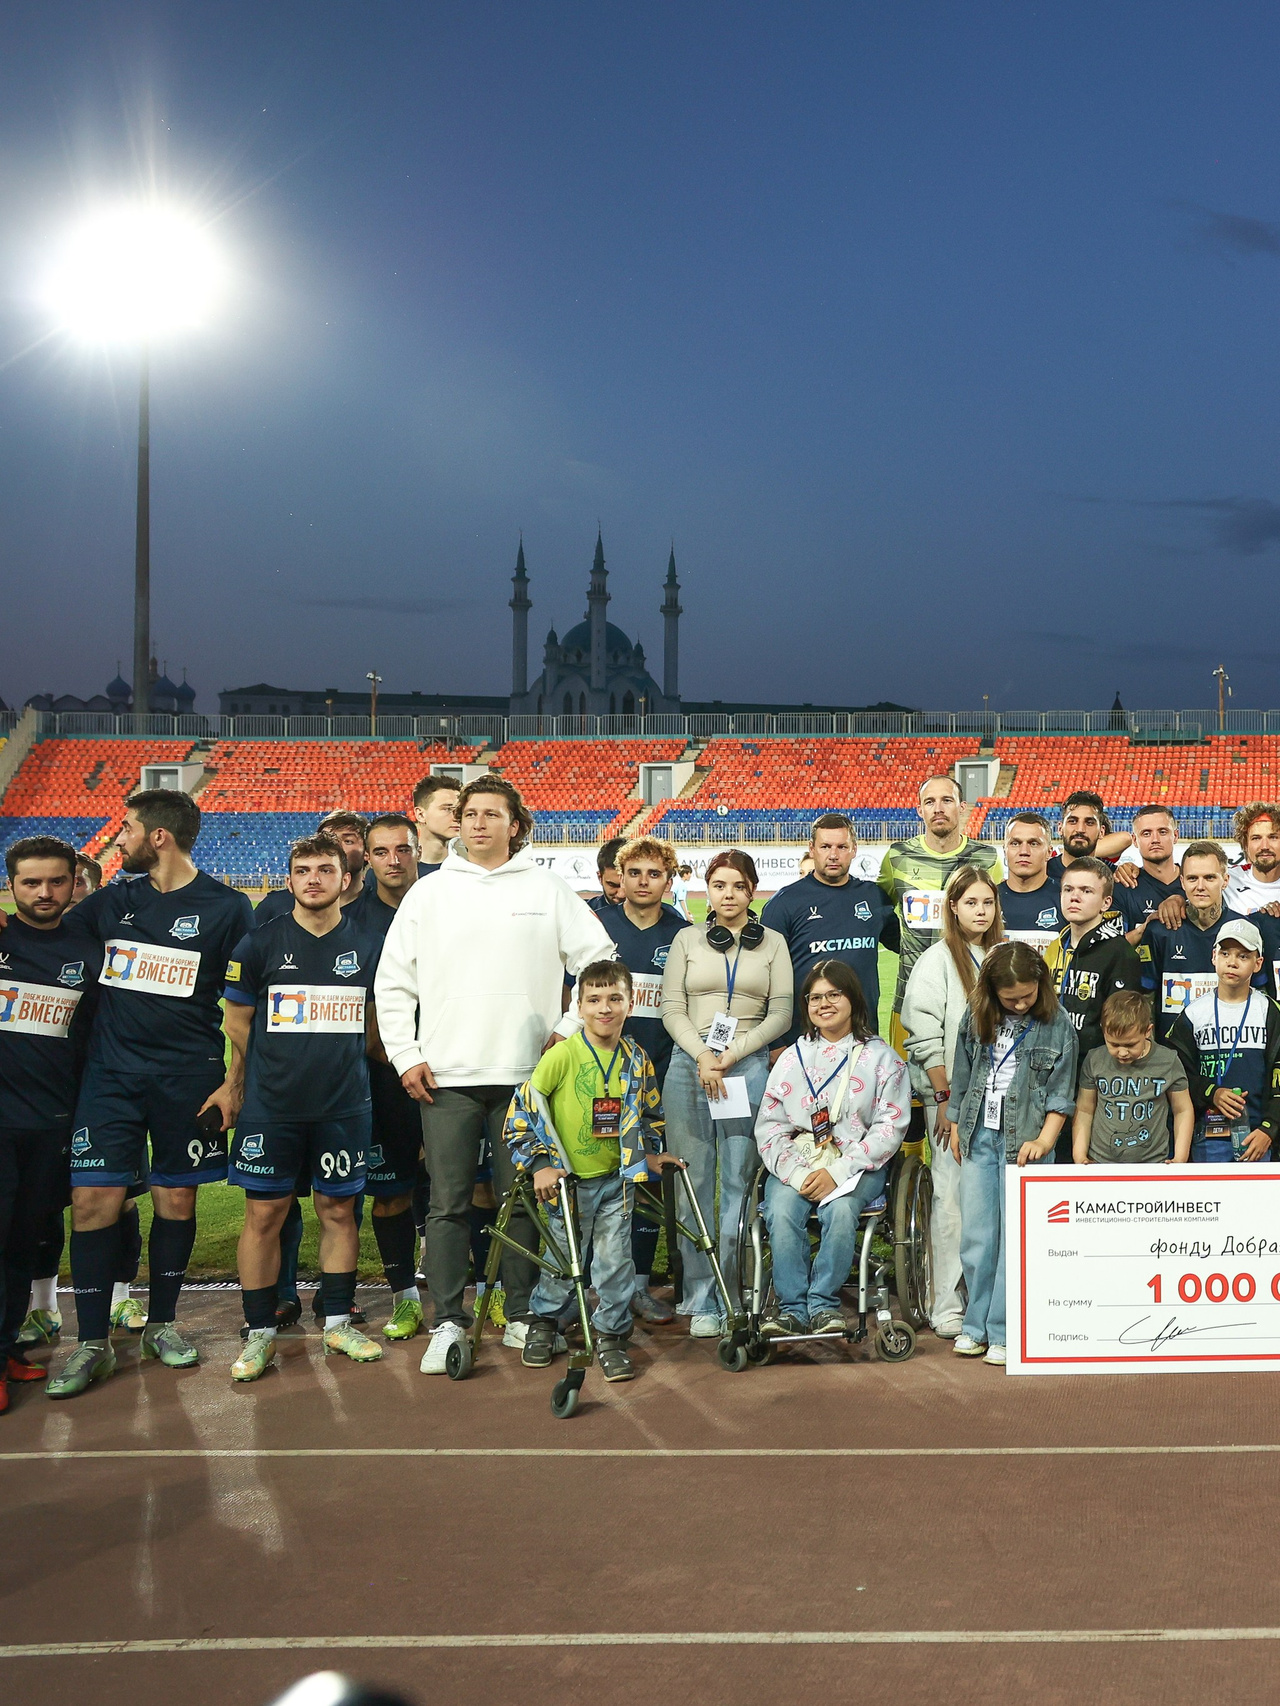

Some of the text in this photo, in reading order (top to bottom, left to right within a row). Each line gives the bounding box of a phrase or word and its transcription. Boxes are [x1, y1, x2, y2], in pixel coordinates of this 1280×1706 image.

[136, 959, 197, 987] ВМЕСТЕ
[23, 992, 56, 1002] ПОБЕЖДАЕМ
[18, 1000, 75, 1026] ВМЕСТЕ
[310, 1002, 363, 1022] ВМЕСТЕ
[1098, 1077, 1166, 1097] DON'T
[1104, 1101, 1154, 1121] STOP
[188, 1139, 204, 1167] 9
[320, 1149, 351, 1179] 90
[1075, 1216, 1183, 1224] ИНВЕСТИЦИОННО-СТРОИТЕЛЬНАЯ
[1048, 1249, 1079, 1258] Выдан
[1149, 1238, 1212, 1259] фонду
[1146, 1273, 1162, 1304] 1
[1177, 1272, 1257, 1304] 000
[1048, 1299, 1093, 1309] На сумму
[1048, 1333, 1090, 1343] Подпись
